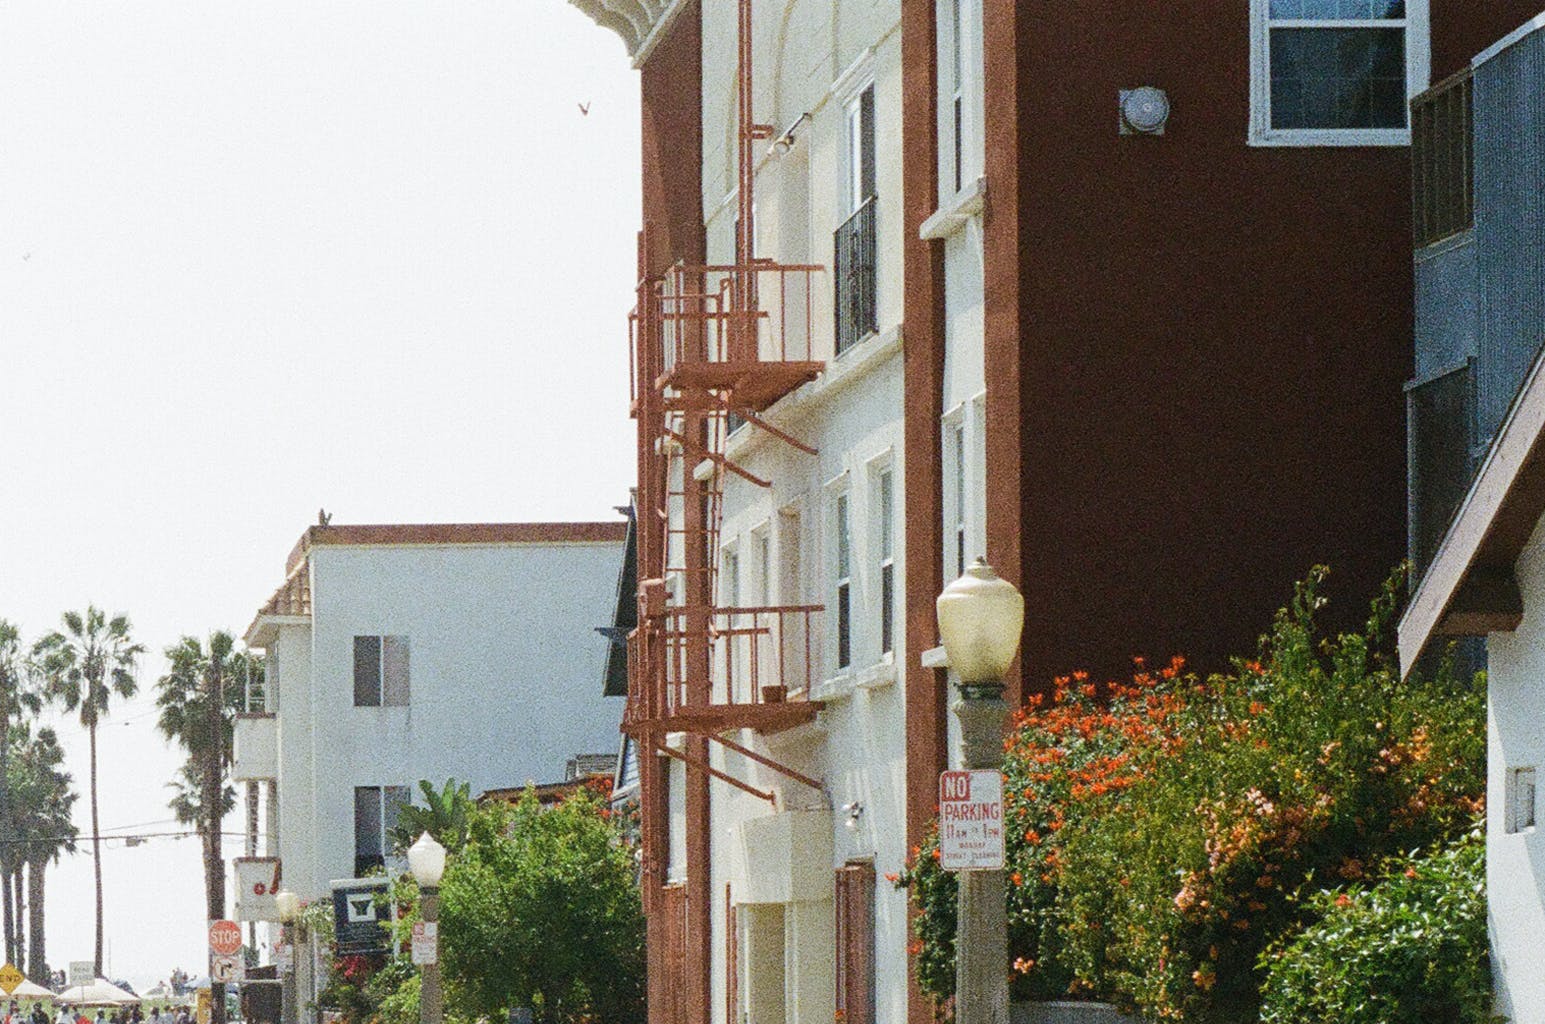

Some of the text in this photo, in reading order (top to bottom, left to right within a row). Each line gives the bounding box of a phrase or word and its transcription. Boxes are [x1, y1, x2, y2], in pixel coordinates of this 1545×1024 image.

[945, 776, 967, 798] NO
[944, 802, 999, 821] PARKING
[210, 931, 240, 944] STOP
